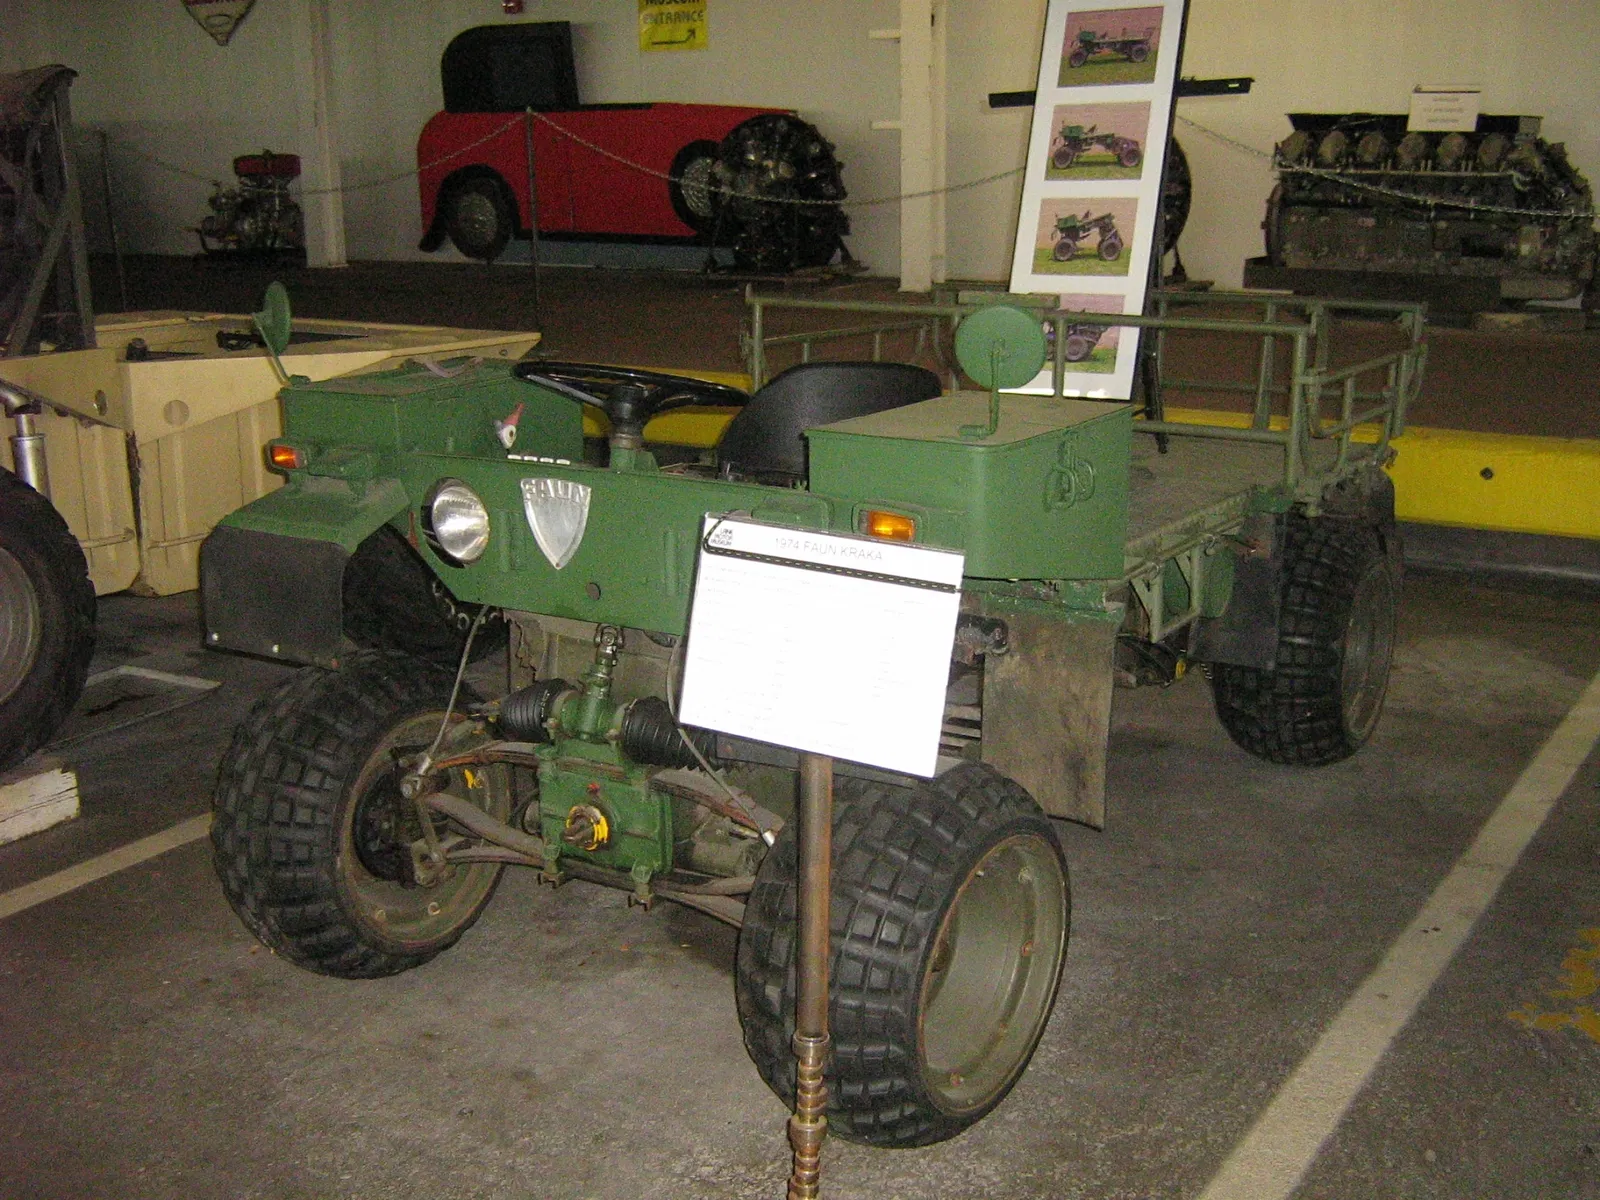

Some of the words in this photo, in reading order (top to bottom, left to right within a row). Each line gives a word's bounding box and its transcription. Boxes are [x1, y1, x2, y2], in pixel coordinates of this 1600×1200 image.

[643, 10, 704, 24] ENTRANCE
[523, 478, 587, 503] FAUN
[775, 537, 799, 550] 1974
[803, 541, 837, 556] FAUN
[840, 546, 883, 561] KRAKA
